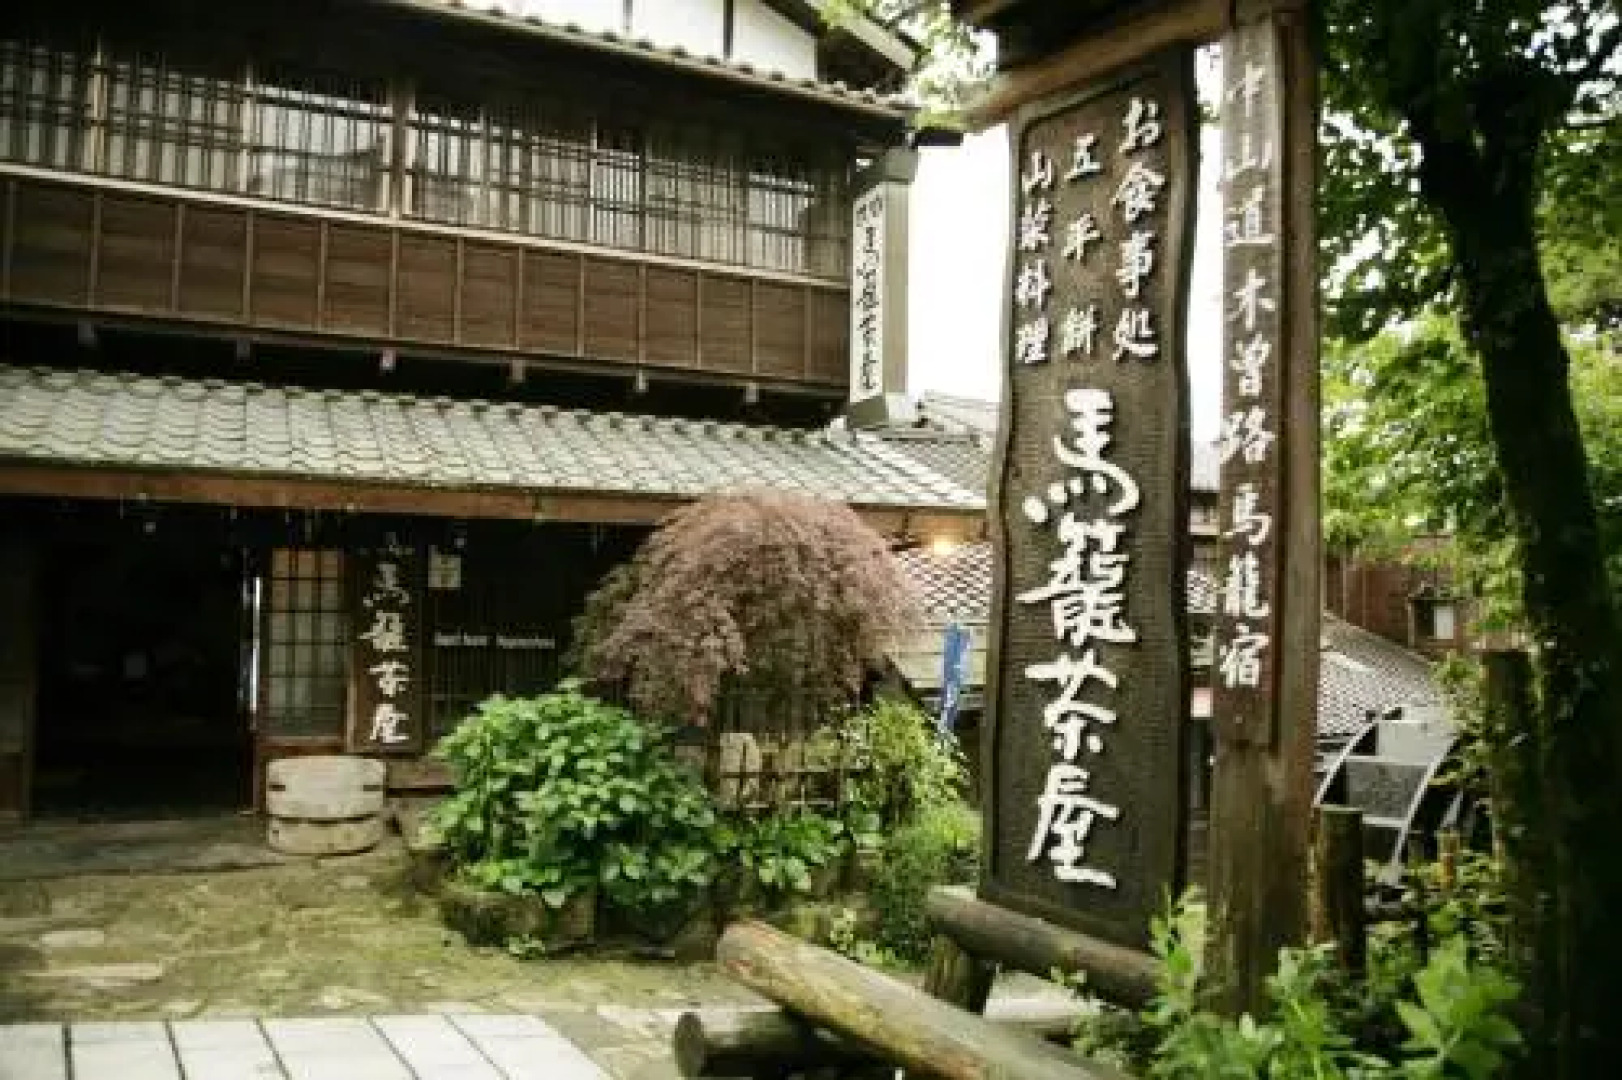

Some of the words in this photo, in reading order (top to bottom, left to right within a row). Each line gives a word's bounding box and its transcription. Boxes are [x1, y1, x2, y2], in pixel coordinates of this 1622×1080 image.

[1015, 151, 1052, 363] 山菜料理
[1113, 97, 1166, 361] お食事処
[1016, 387, 1139, 888] 馬籠茶屋
